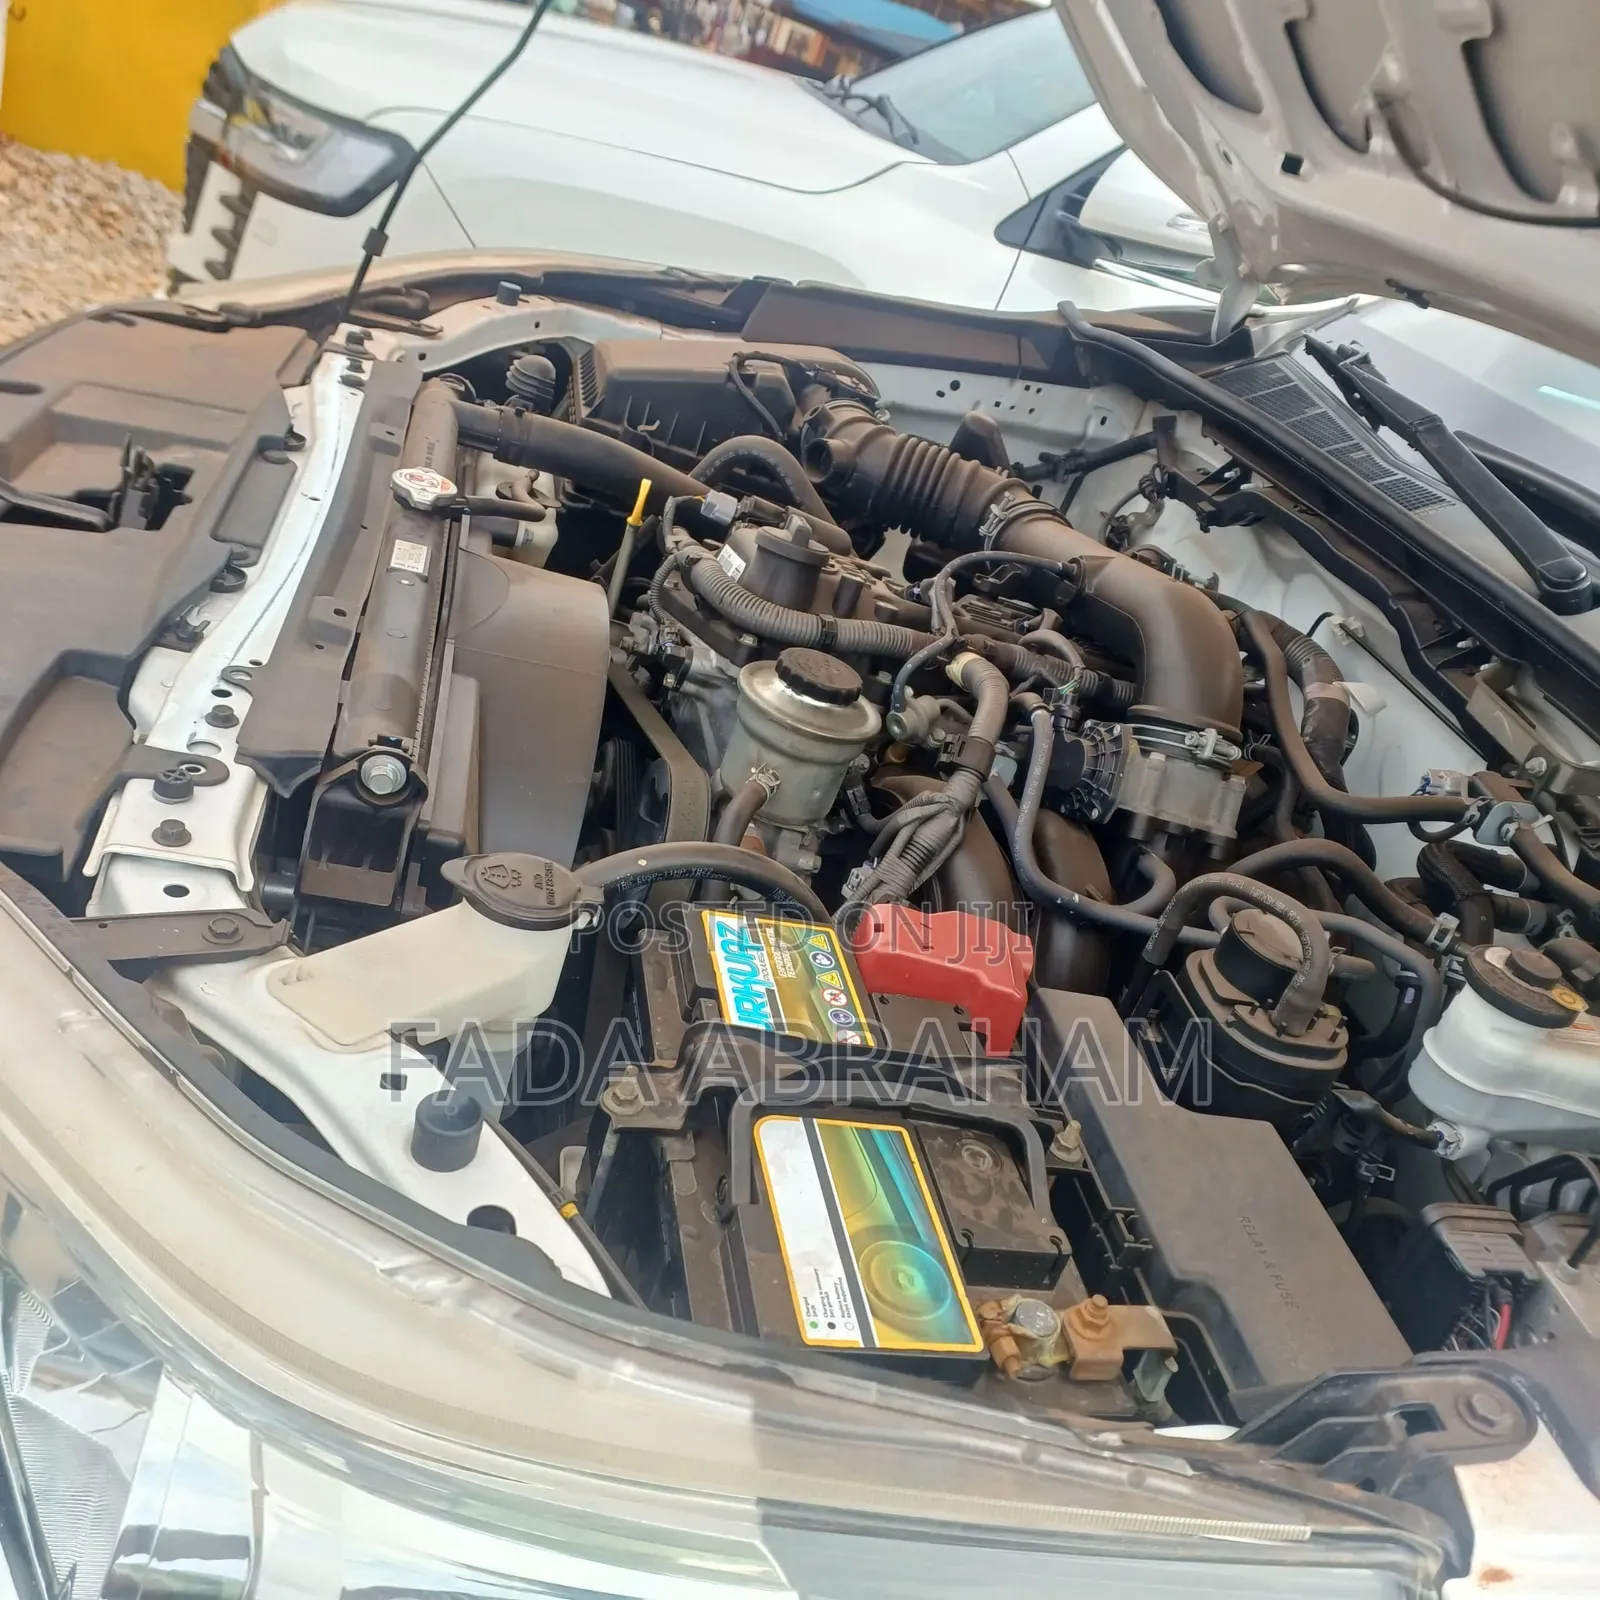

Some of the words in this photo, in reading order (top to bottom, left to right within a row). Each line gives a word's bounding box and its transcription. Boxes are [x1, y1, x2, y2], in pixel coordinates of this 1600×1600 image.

[1238, 1215, 1268, 1256] RELAY
[1263, 1260, 1276, 1270] &
[1270, 1274, 1300, 1310] FUSE
